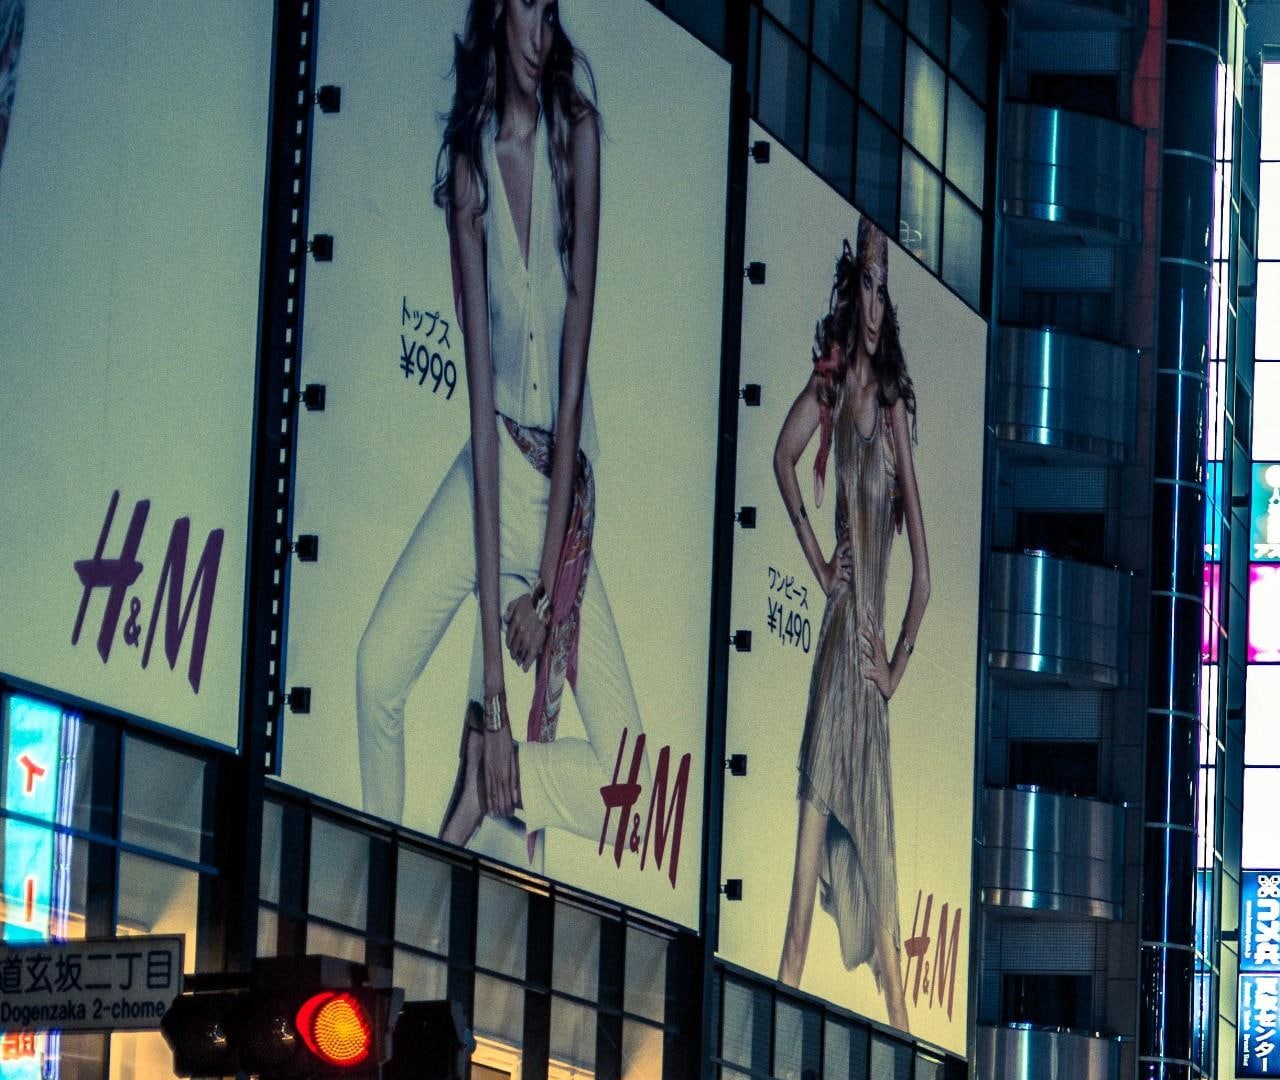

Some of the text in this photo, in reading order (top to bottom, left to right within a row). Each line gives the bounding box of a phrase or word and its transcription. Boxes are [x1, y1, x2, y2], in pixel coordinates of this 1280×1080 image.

[401, 296, 451, 349] トップス
[400, 335, 458, 400] ¥999
[72, 489, 225, 694] H&M
[768, 565, 809, 609] ワンピース
[768, 597, 812, 653] ¥1,490
[600, 727, 692, 889] H&M
[0, 949, 172, 995] 道玄坂二丁目
[902, 889, 963, 1023] H&M
[91, 998, 165, 1020] 2-chome
